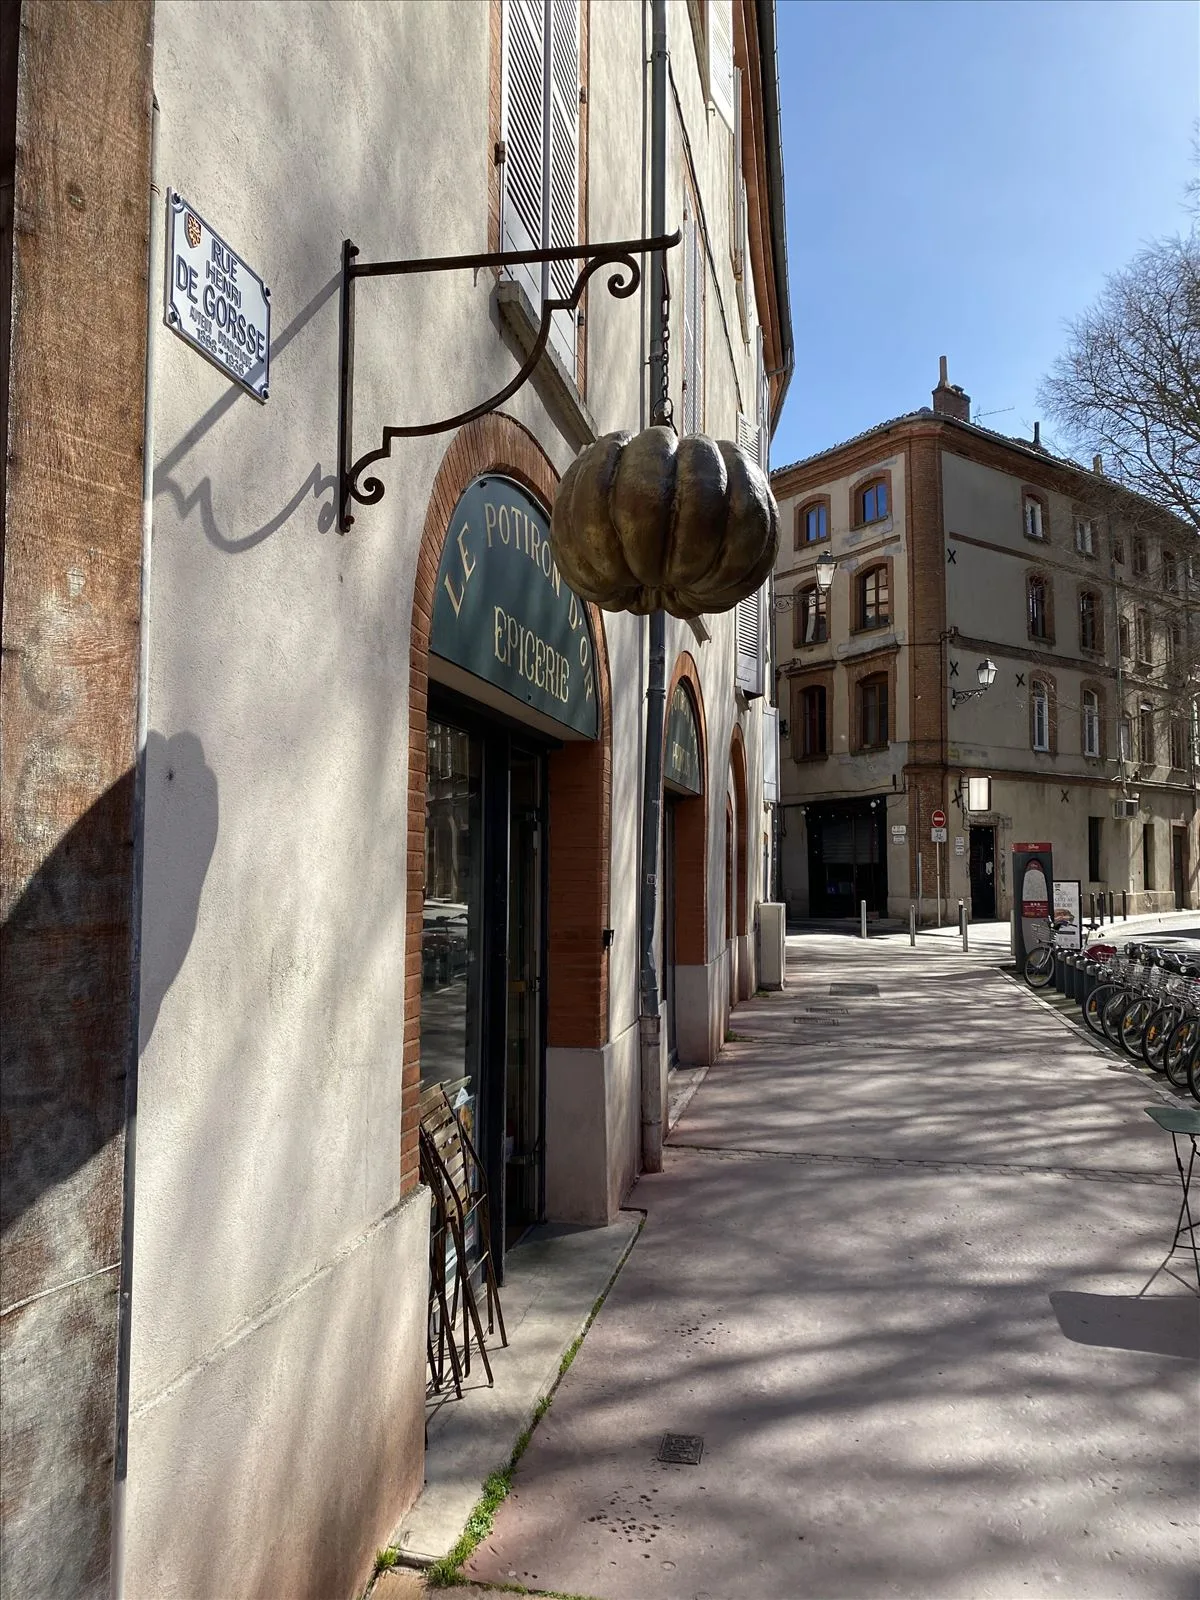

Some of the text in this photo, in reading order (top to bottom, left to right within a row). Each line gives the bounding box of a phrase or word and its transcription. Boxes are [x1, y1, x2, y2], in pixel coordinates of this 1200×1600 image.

[176, 254, 265, 363] DE GORSSE
[205, 260, 242, 309] HENRI
[211, 238, 238, 283] RUE
[444, 521, 476, 618] LE
[484, 502, 561, 598] POTIRON
[493, 605, 570, 704] EPICERIE
